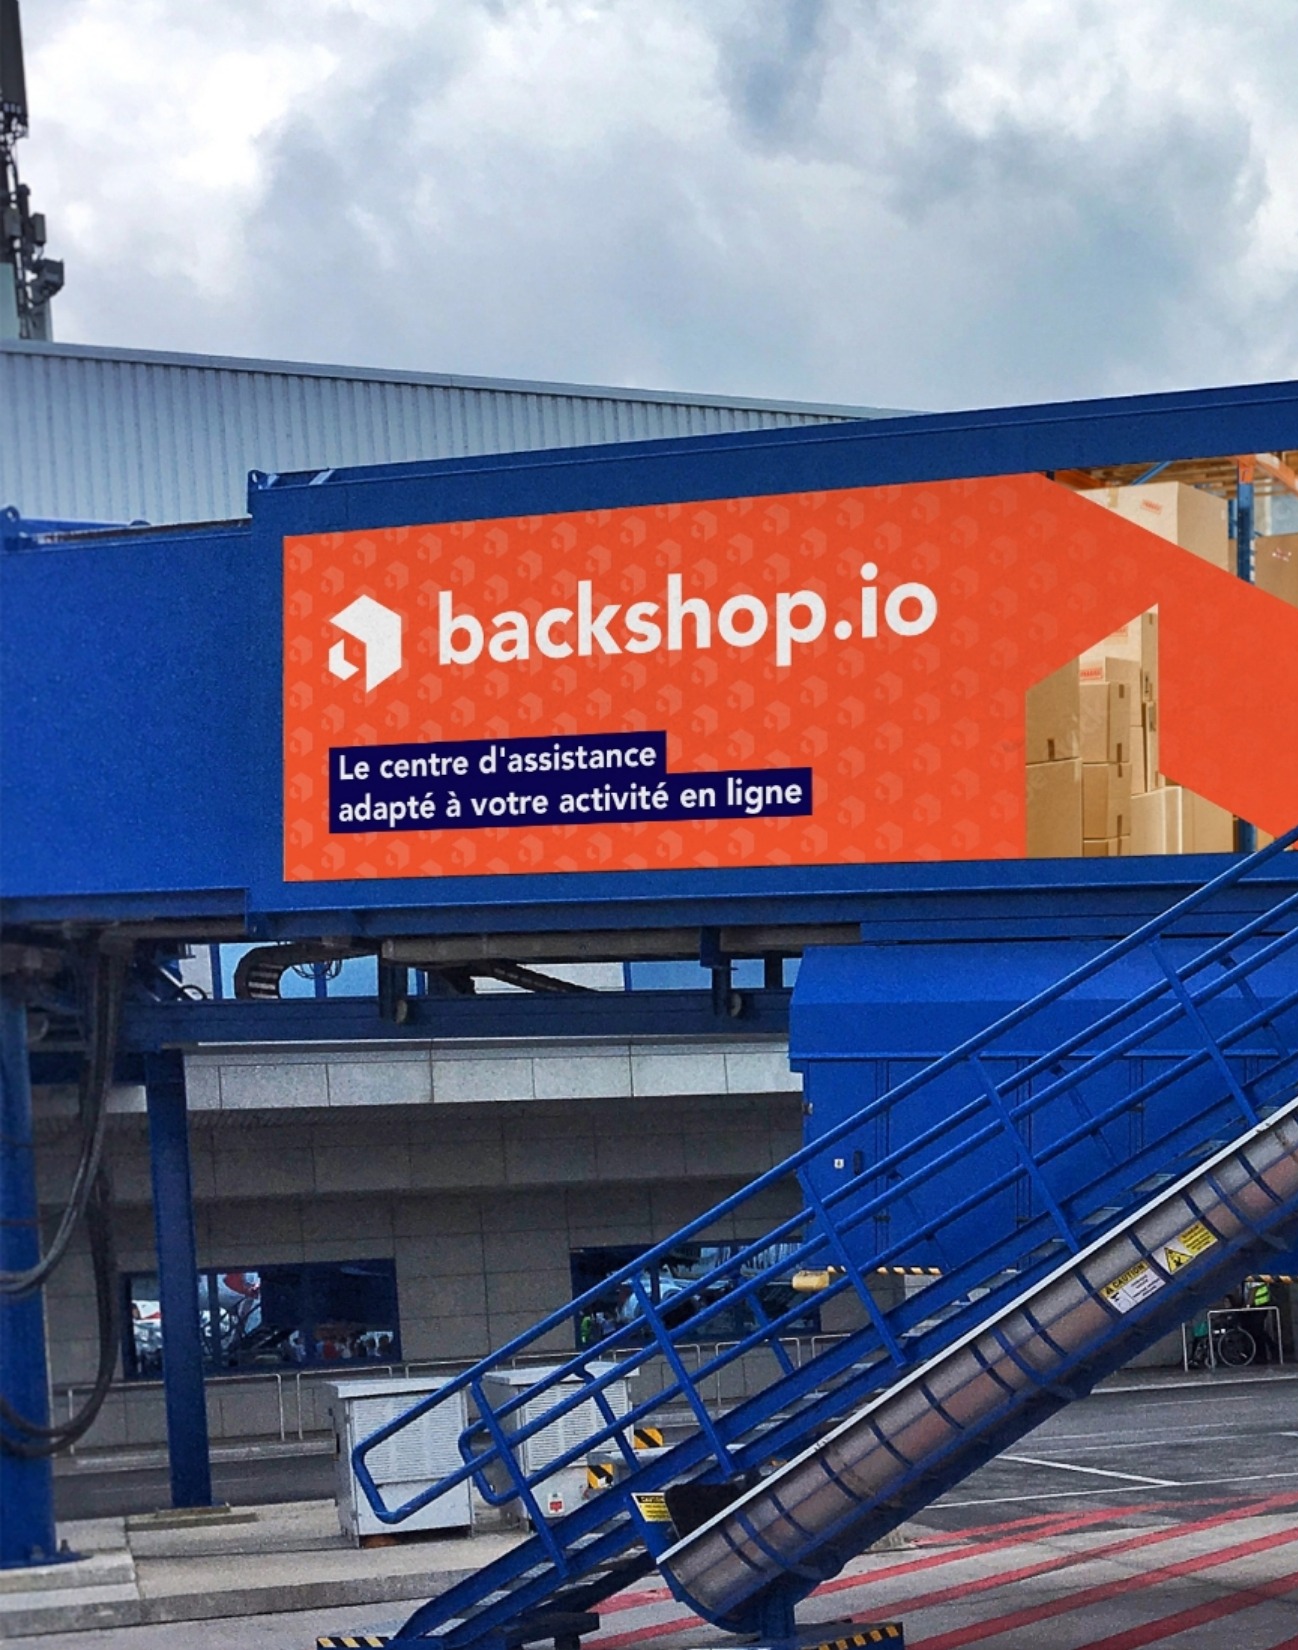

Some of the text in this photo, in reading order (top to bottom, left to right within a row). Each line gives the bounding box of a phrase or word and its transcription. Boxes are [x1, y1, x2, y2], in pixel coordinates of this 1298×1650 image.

[438, 562, 938, 667] backshop.io
[339, 742, 657, 781] Le centre d'assistance
[338, 776, 803, 828] adapté à votre activité en ligne
[1112, 1261, 1145, 1288] CAUTION
